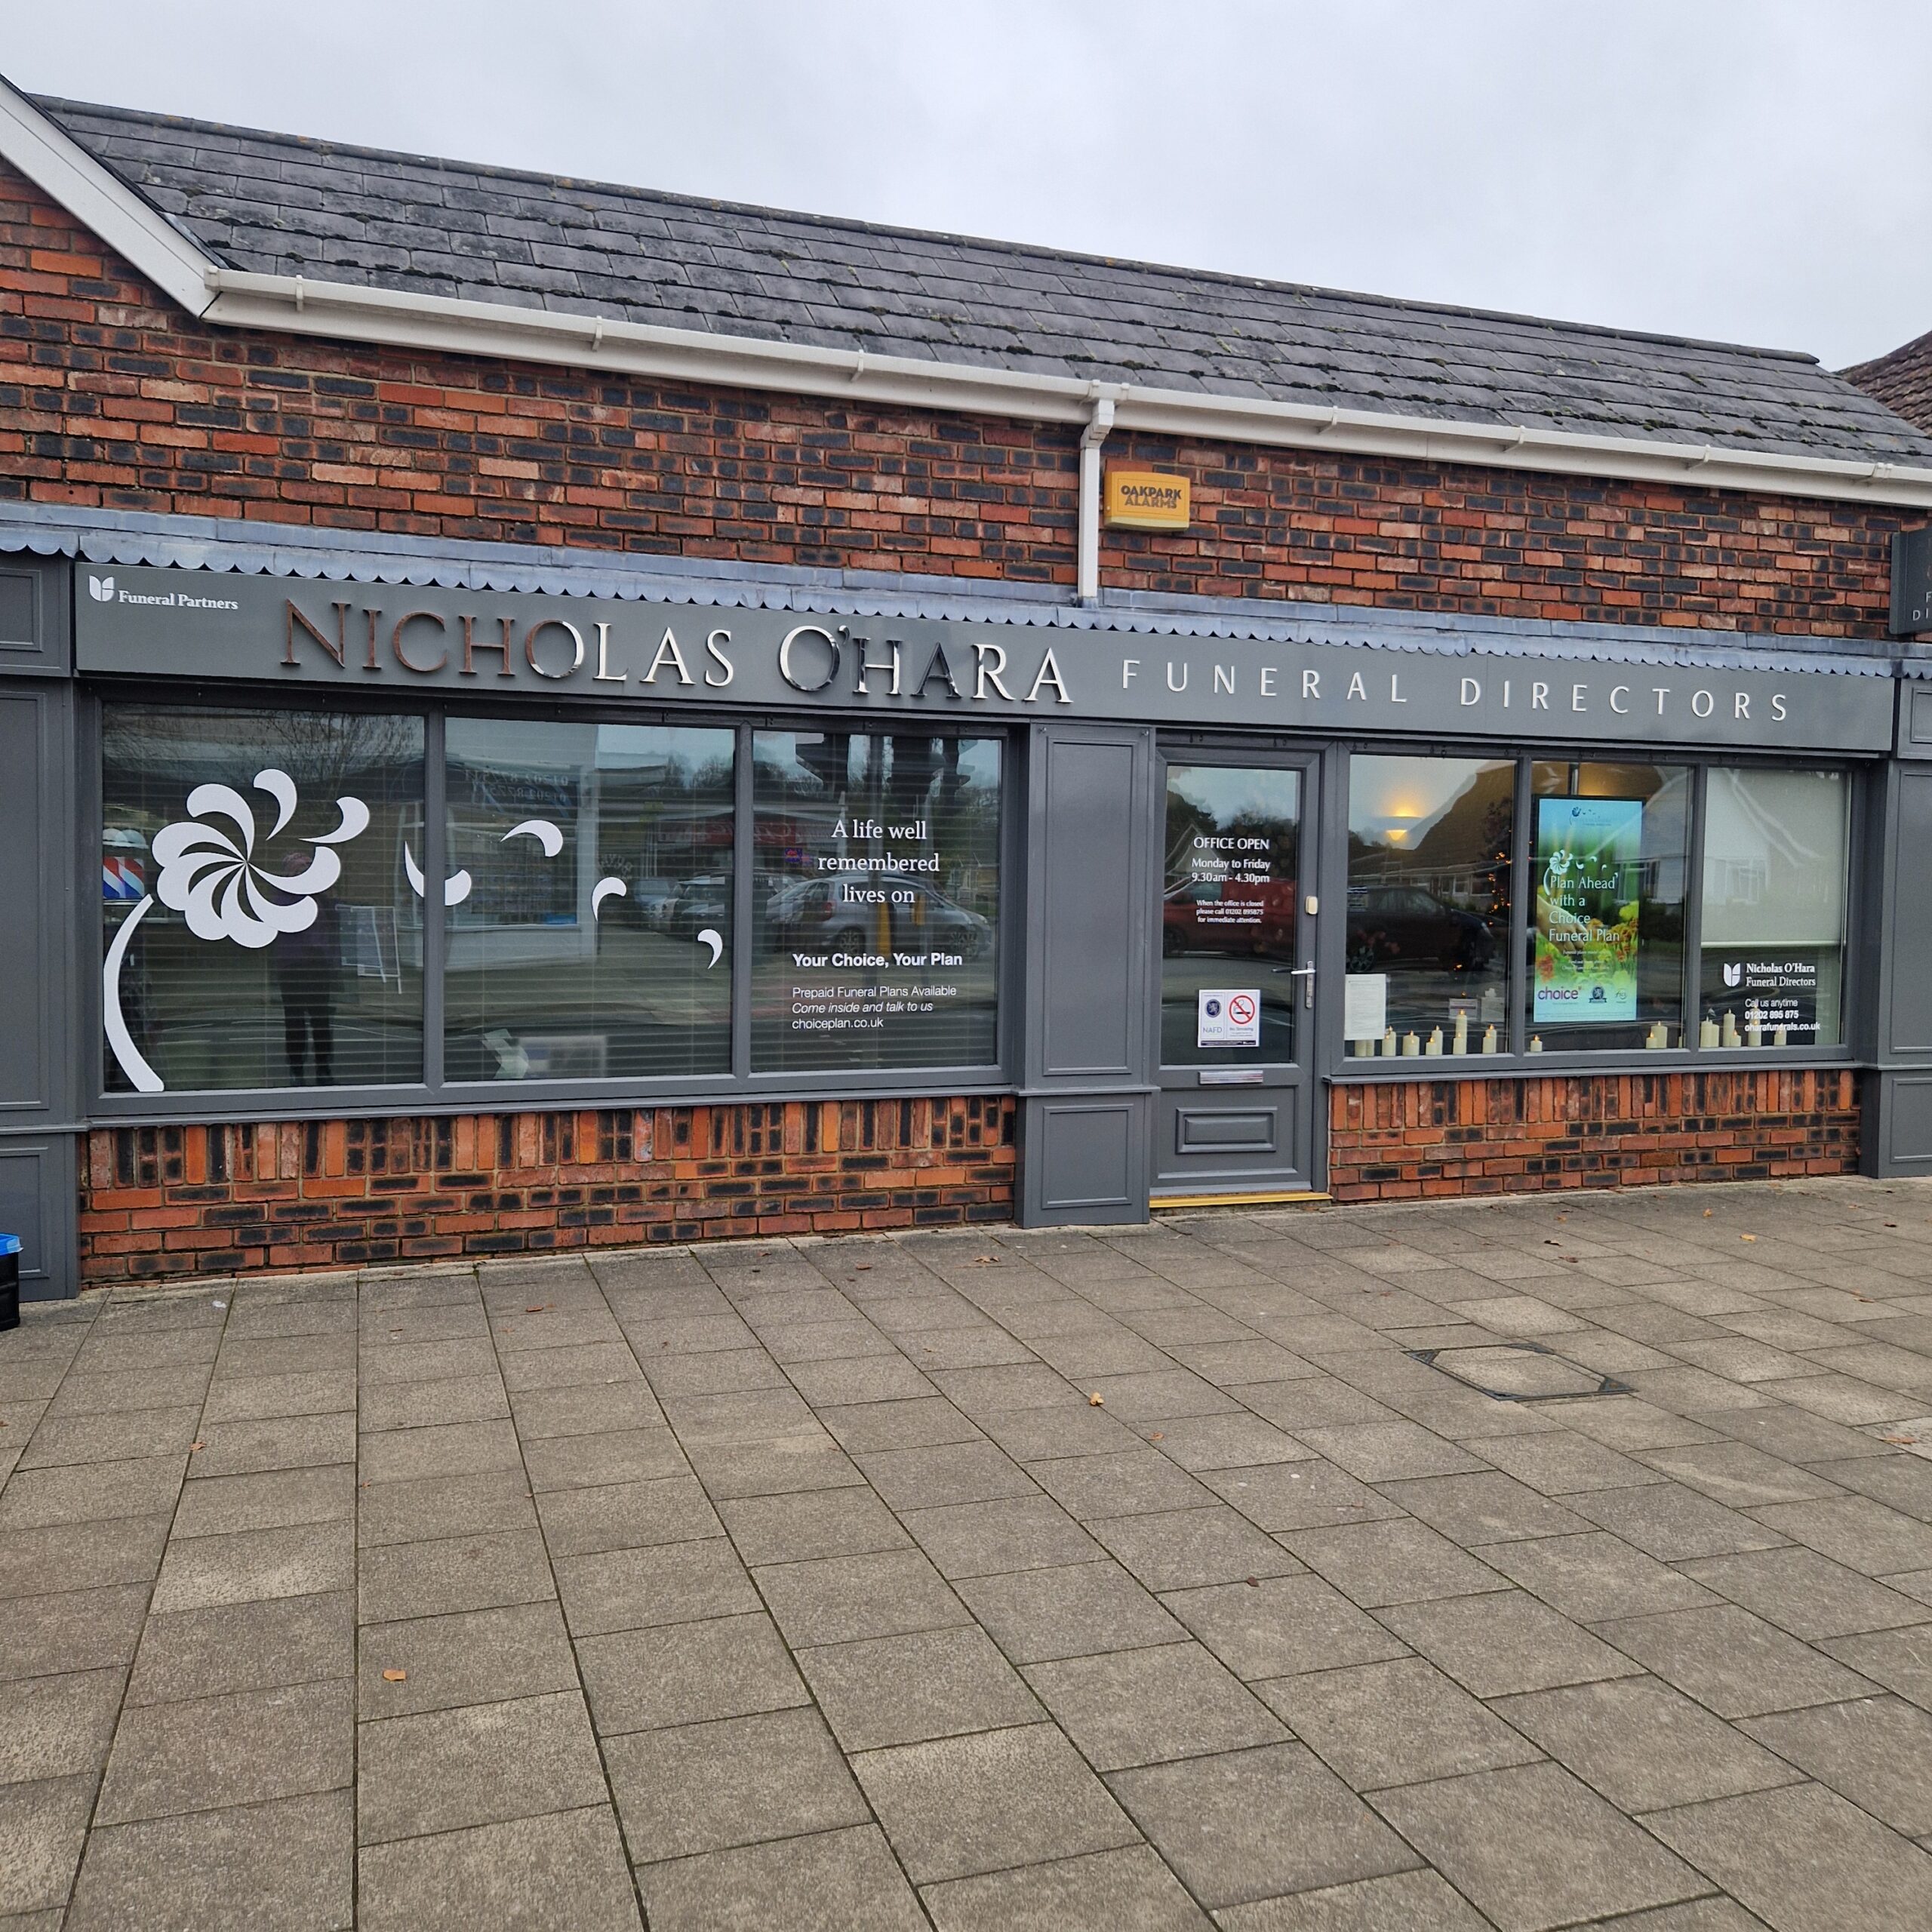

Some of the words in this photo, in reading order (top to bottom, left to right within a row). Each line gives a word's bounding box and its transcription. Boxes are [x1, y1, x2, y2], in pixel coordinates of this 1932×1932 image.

[1121, 485, 1182, 500] OAKPARK
[1124, 495, 1177, 509] ALARMS
[118, 590, 175, 606] Funeral
[177, 593, 238, 610] Partners
[281, 598, 734, 688] NICHOLAS
[779, 625, 1072, 703] O'HARA
[1122, 660, 1407, 703] FUNERAL
[1460, 674, 1787, 721] DIRECTORS
[831, 823, 848, 838] A
[853, 819, 883, 838] life
[888, 820, 927, 839] well
[1193, 837, 1234, 849] OFFICE
[1237, 838, 1269, 850] OPEN
[818, 852, 940, 872] remembered
[1192, 858, 1229, 870] Monday
[1232, 860, 1241, 869] to
[1243, 859, 1271, 872] Friday
[1192, 872, 1227, 882] 9.30am
[1235, 873, 1270, 885] 4.30pm
[1550, 875, 1574, 889] Plan
[1579, 876, 1615, 889] Ahead
[842, 884, 885, 903] lives
[891, 890, 915, 903] on
[1550, 894, 1575, 906] with
[1579, 897, 1586, 906] a
[1549, 912, 1591, 924] Choice
[1549, 930, 1592, 943] Funeral
[1596, 930, 1620, 942] Plan
[792, 953, 828, 967] Your
[832, 953, 889, 968] Choice,
[893, 953, 927, 966] Your
[931, 952, 963, 966] Plan
[1746, 963, 1783, 973] Nicholas
[1784, 963, 1815, 973] O'Hara
[1746, 977, 1777, 987] Funeral
[1779, 977, 1816, 987] Directors
[792, 986, 834, 999] Prepaid
[838, 986, 876, 997] Funeral
[879, 986, 909, 997] Plans
[911, 986, 957, 996] Available
[1538, 986, 1579, 1000] choice
[792, 1003, 826, 1014] Come
[828, 1001, 860, 1014] inside
[862, 1001, 883, 1013] and
[886, 1001, 905, 1013] talk
[907, 1001, 918, 1012] to
[920, 1002, 934, 1012] us
[1745, 998, 1758, 1008] Call
[1770, 998, 1798, 1008] anytime
[1745, 1011, 1767, 1019] 01202
[1770, 1011, 1783, 1019] 895
[1785, 1011, 1799, 1019] 875
[792, 1017, 884, 1030] choiceplan.co.uk
[1745, 1022, 1821, 1032] oharafunerals.co.uk
